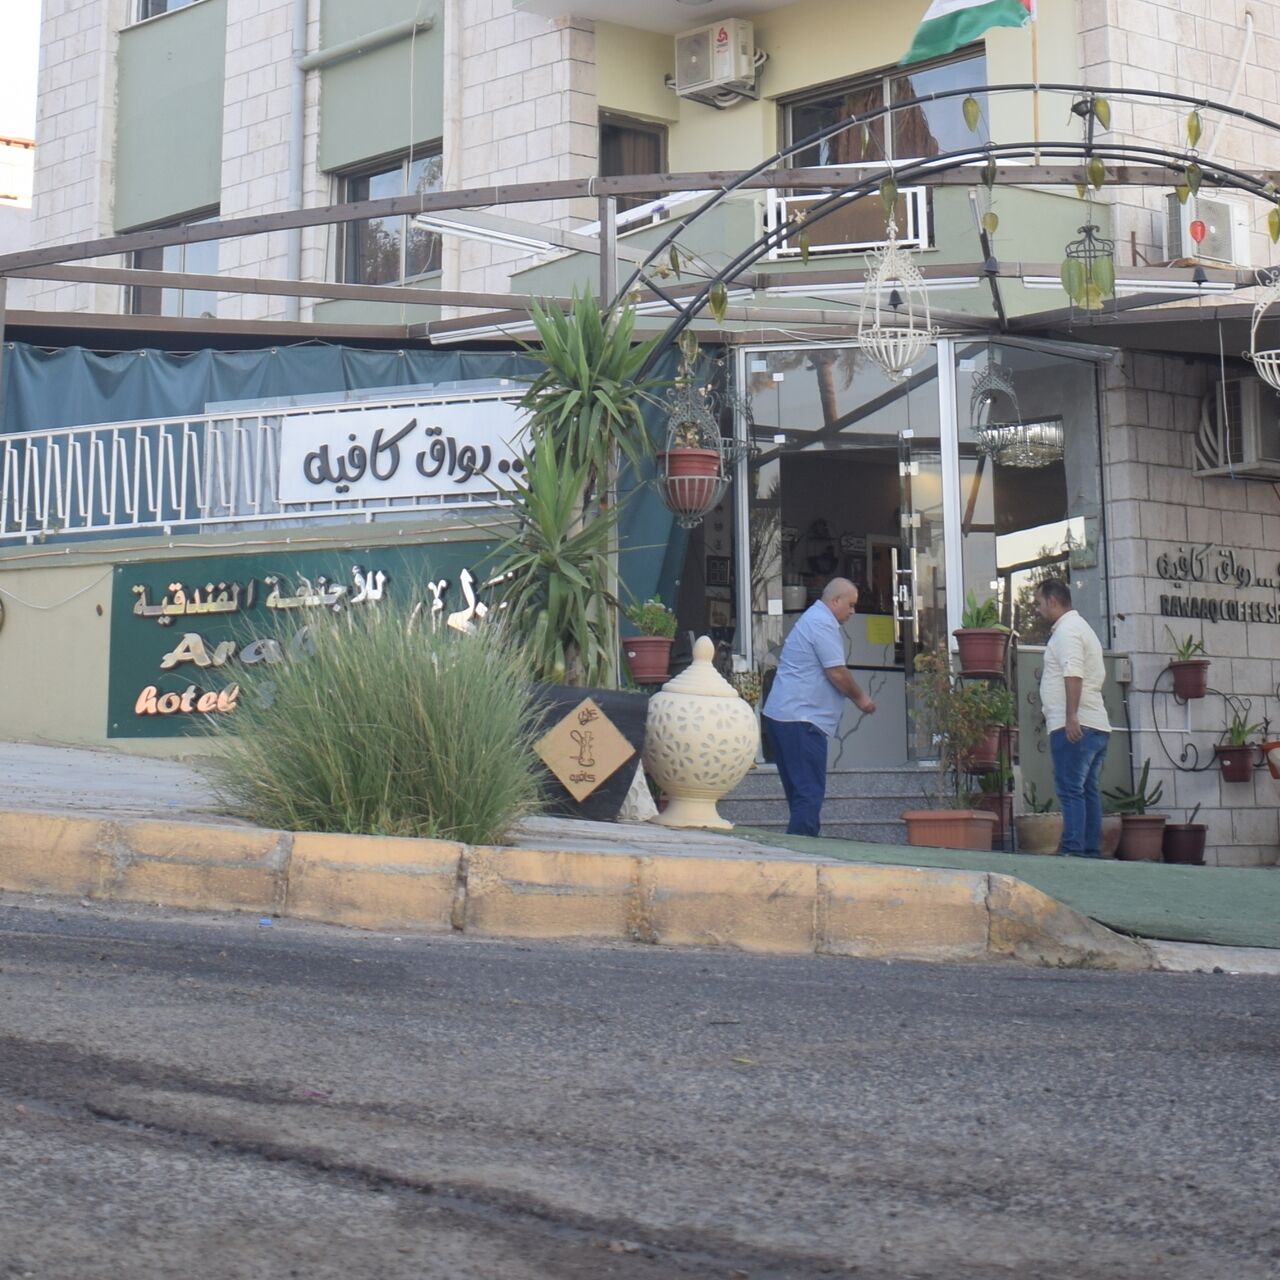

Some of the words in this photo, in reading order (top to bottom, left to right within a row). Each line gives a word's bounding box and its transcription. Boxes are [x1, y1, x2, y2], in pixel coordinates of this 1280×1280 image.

[303, 418, 418, 494] كافيه
[415, 426, 492, 484] رواق
[134, 681, 241, 716] hotel
